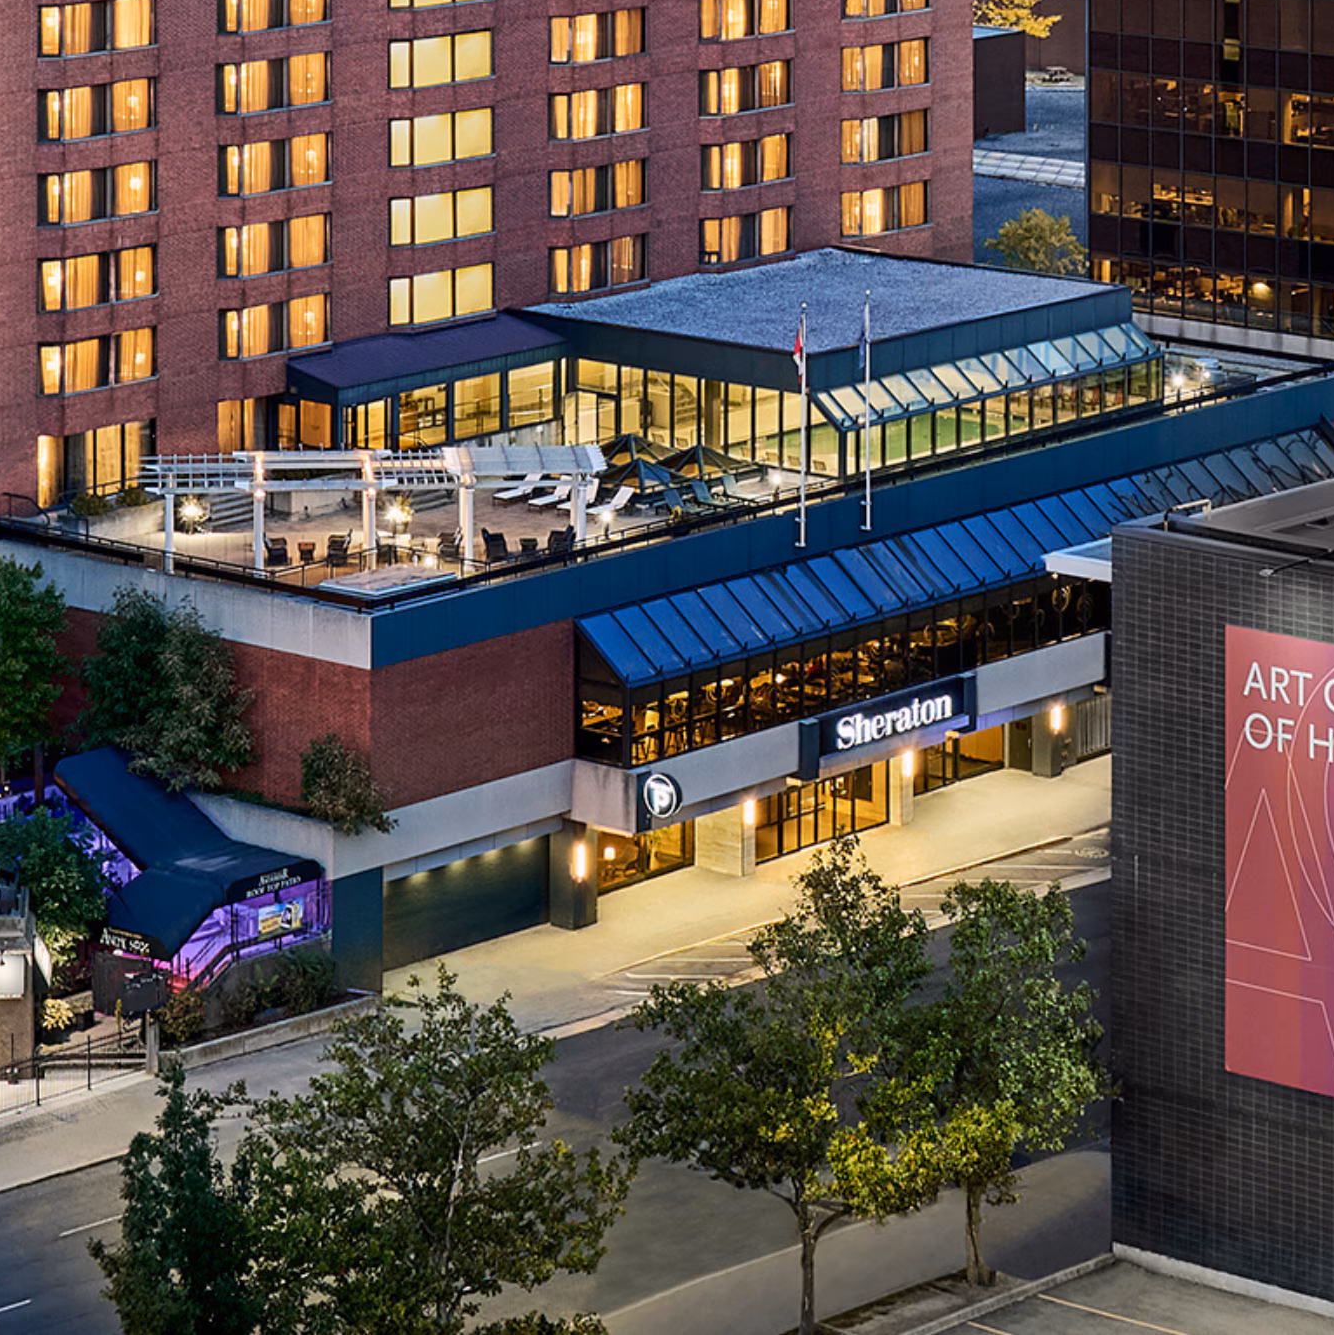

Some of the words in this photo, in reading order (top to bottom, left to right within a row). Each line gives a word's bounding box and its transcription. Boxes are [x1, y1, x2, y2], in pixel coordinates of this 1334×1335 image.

[1243, 662, 1312, 707] ART
[836, 695, 952, 749] Sheraton
[1244, 713, 1295, 753] OF
